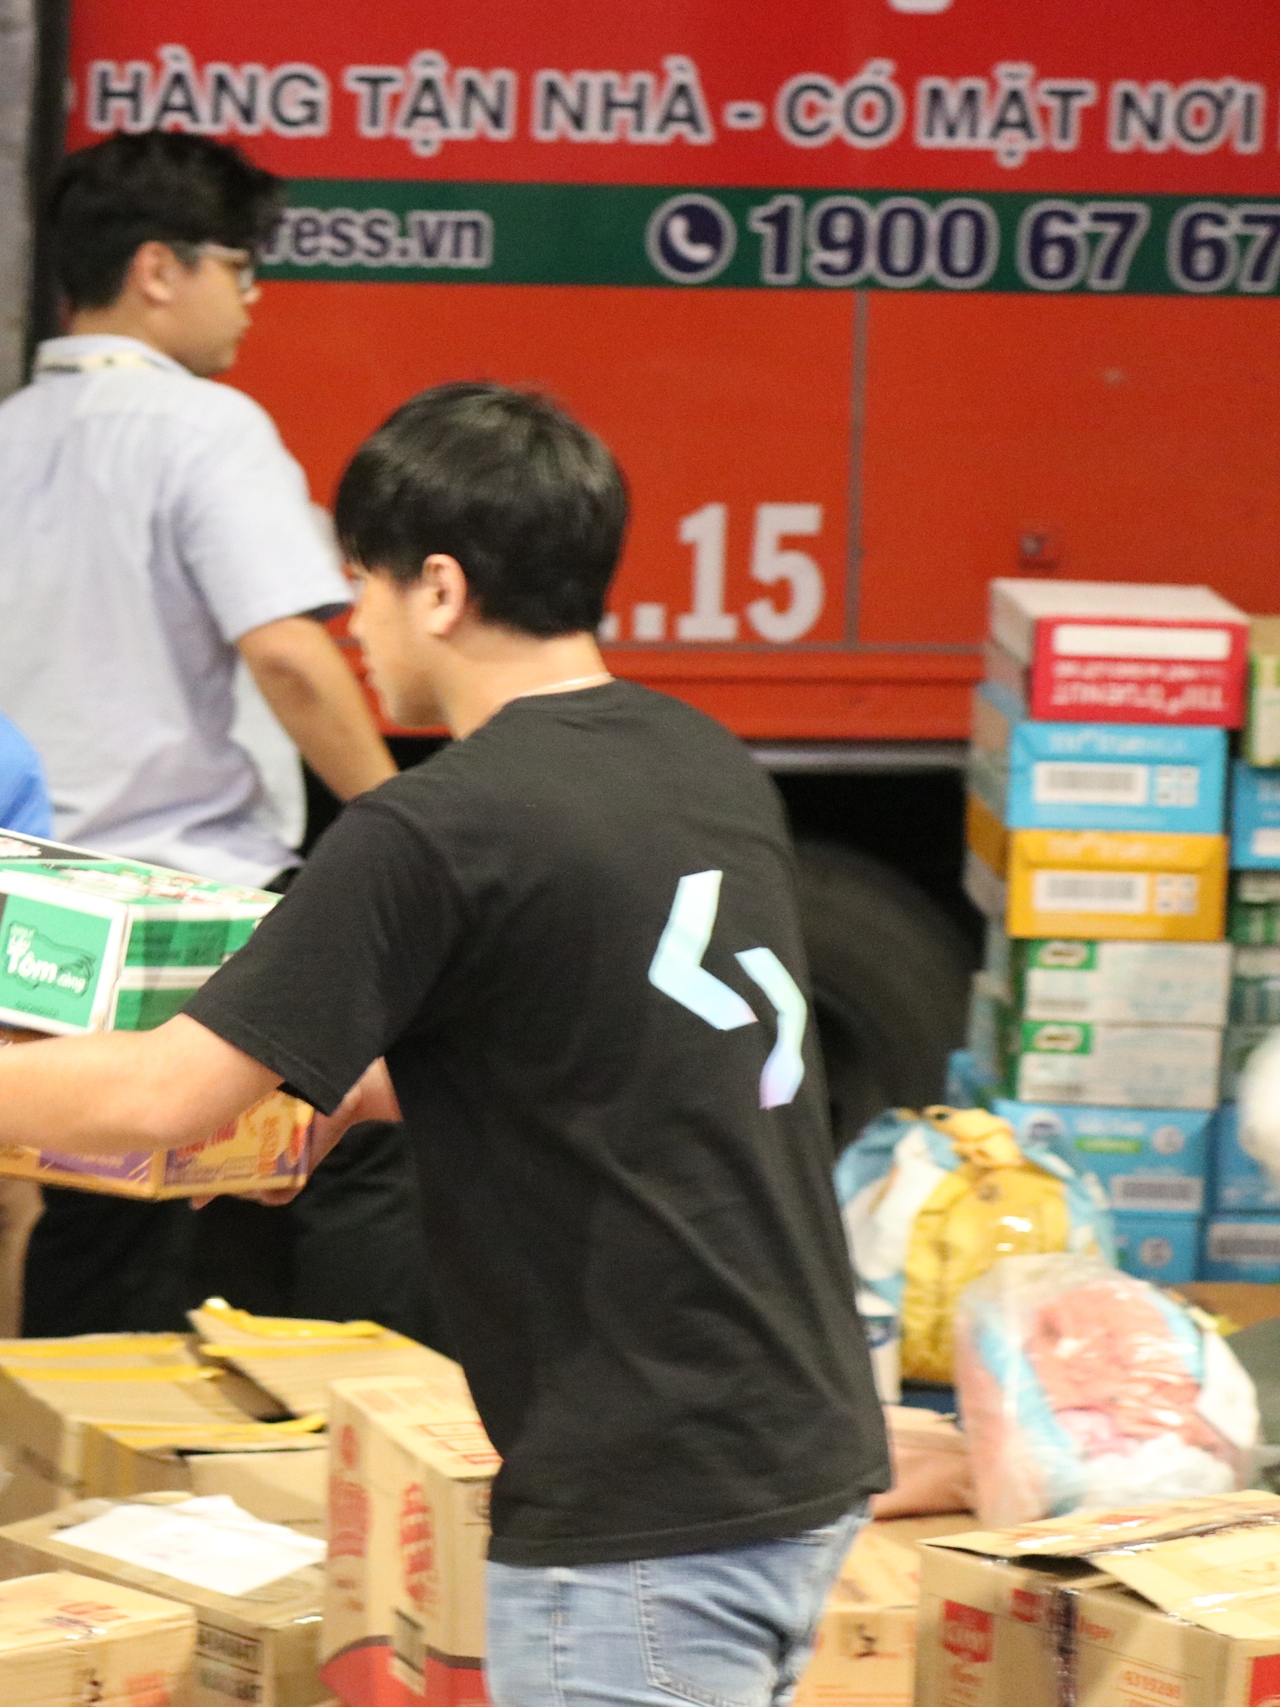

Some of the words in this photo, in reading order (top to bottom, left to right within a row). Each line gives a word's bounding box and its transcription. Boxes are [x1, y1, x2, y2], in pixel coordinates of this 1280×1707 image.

[90, 46, 326, 132] HÀNG
[348, 53, 512, 153] TẬN
[536, 57, 710, 142] NHÀ
[780, 61, 902, 148] CÓ
[919, 63, 1094, 166] MẶT
[1112, 80, 1261, 152] NƠI
[752, 196, 997, 287] 1900
[1019, 203, 1149, 291] 67
[1170, 203, 1280, 292] 67
